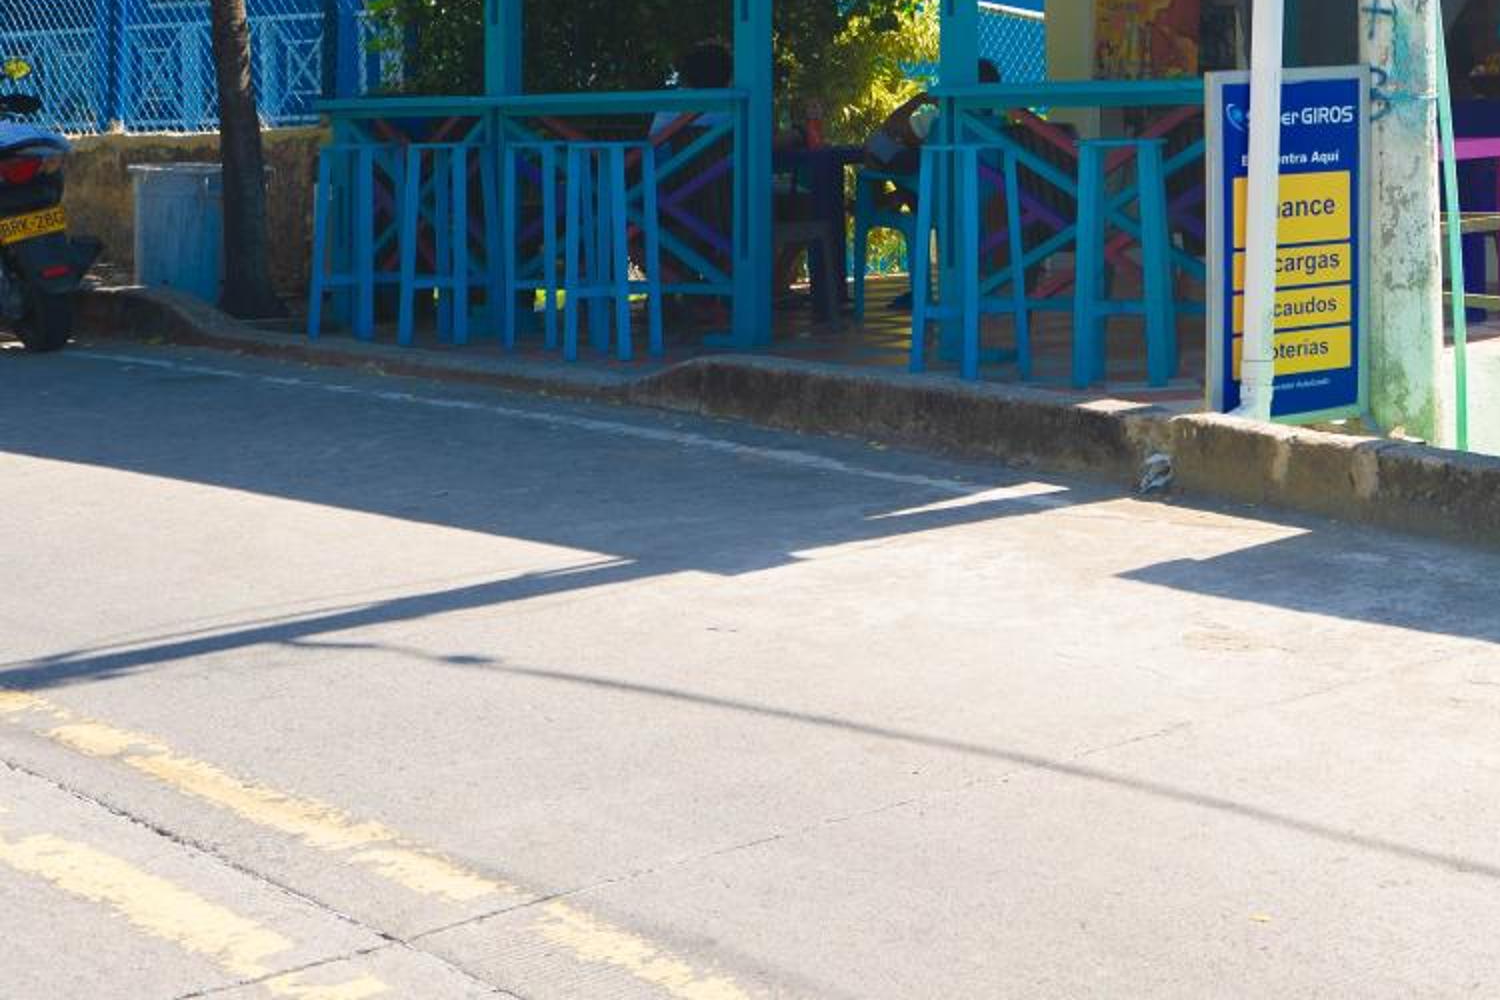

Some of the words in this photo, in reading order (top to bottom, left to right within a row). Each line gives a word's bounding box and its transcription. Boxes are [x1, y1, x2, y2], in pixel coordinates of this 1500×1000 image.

[1311, 149, 1340, 165] Aquí
[1277, 198, 1336, 219] ance
[1275, 252, 1340, 275] cargas
[1273, 296, 1337, 318] caudos
